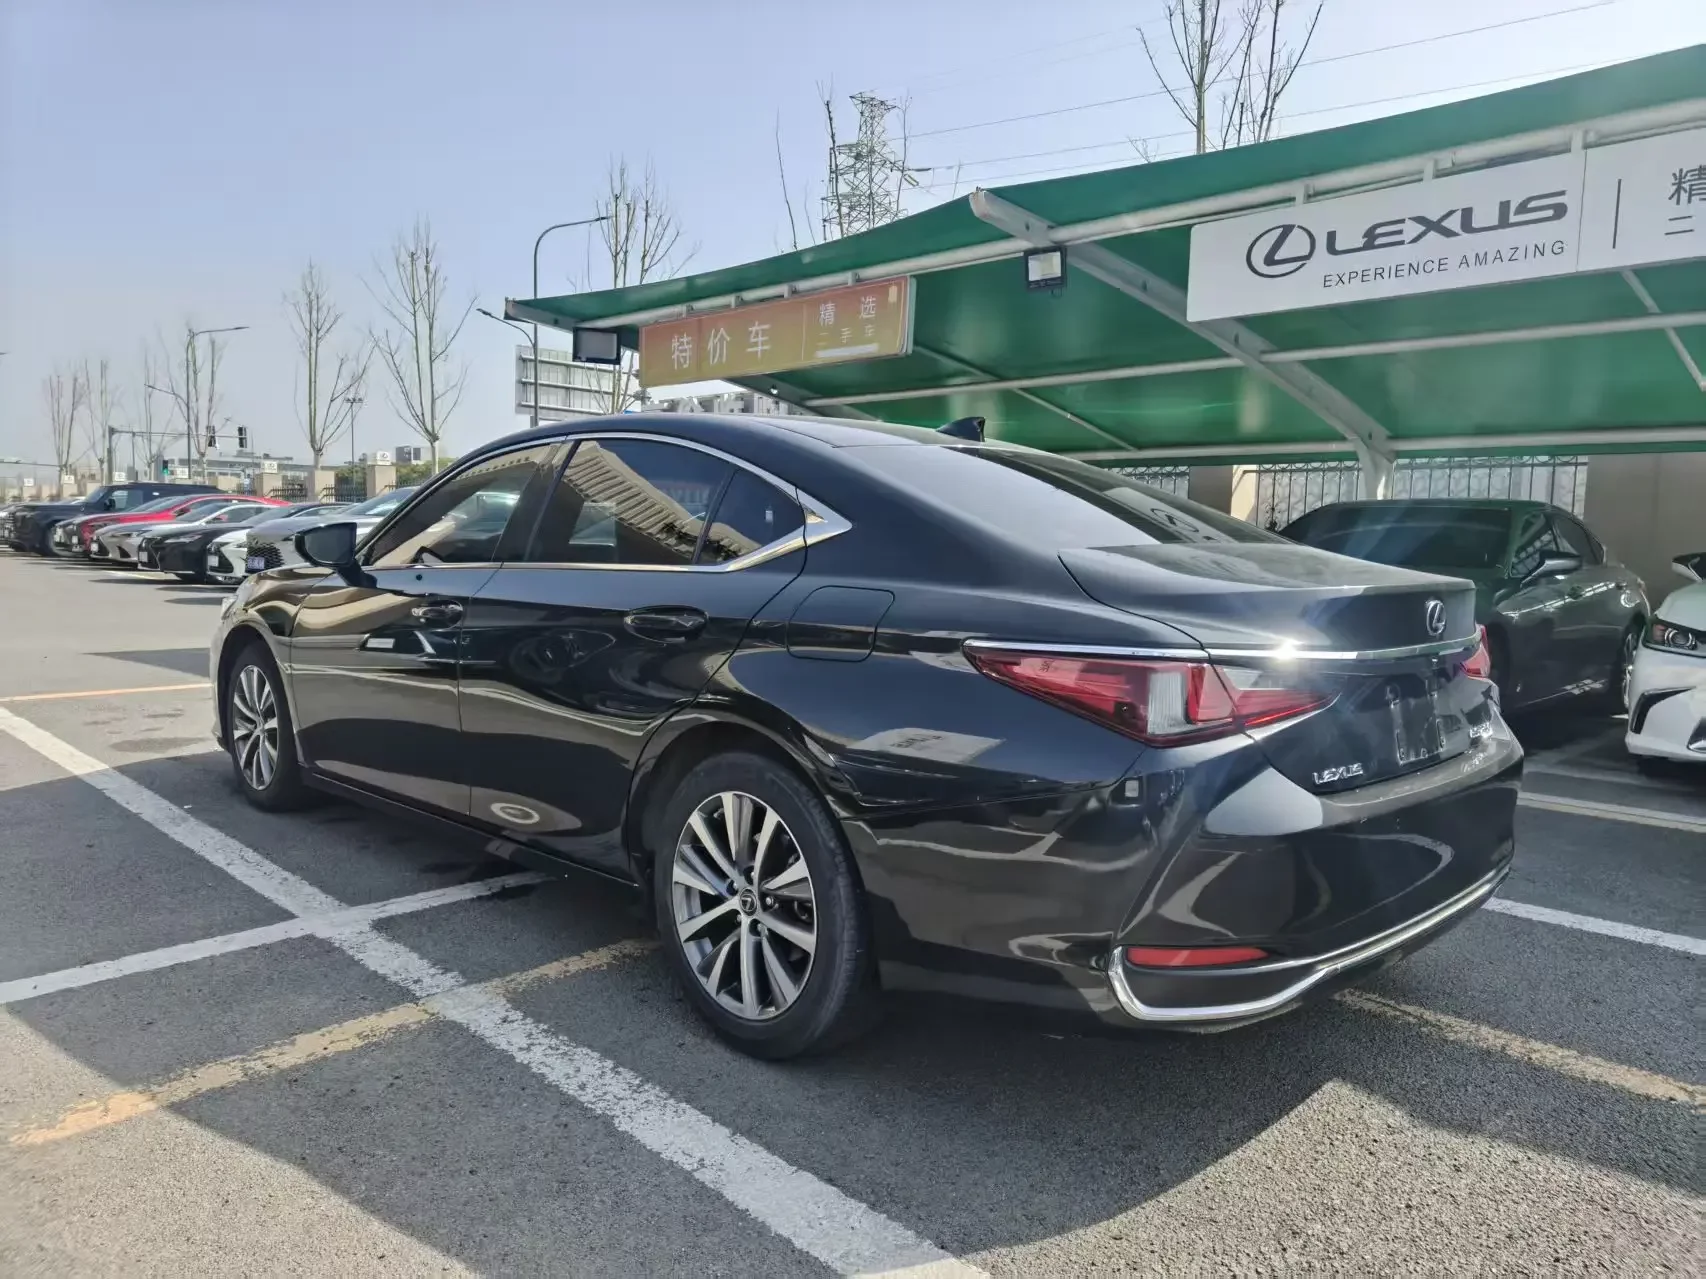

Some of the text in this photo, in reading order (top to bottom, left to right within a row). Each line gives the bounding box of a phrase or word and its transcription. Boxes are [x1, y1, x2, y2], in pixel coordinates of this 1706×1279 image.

[1325, 189, 1569, 256] LEXUS
[1322, 239, 1566, 288] EXPERIENCE AMAZING
[819, 295, 877, 327] 精选
[671, 320, 772, 370] 特价车
[1311, 762, 1364, 785] LEXUS
